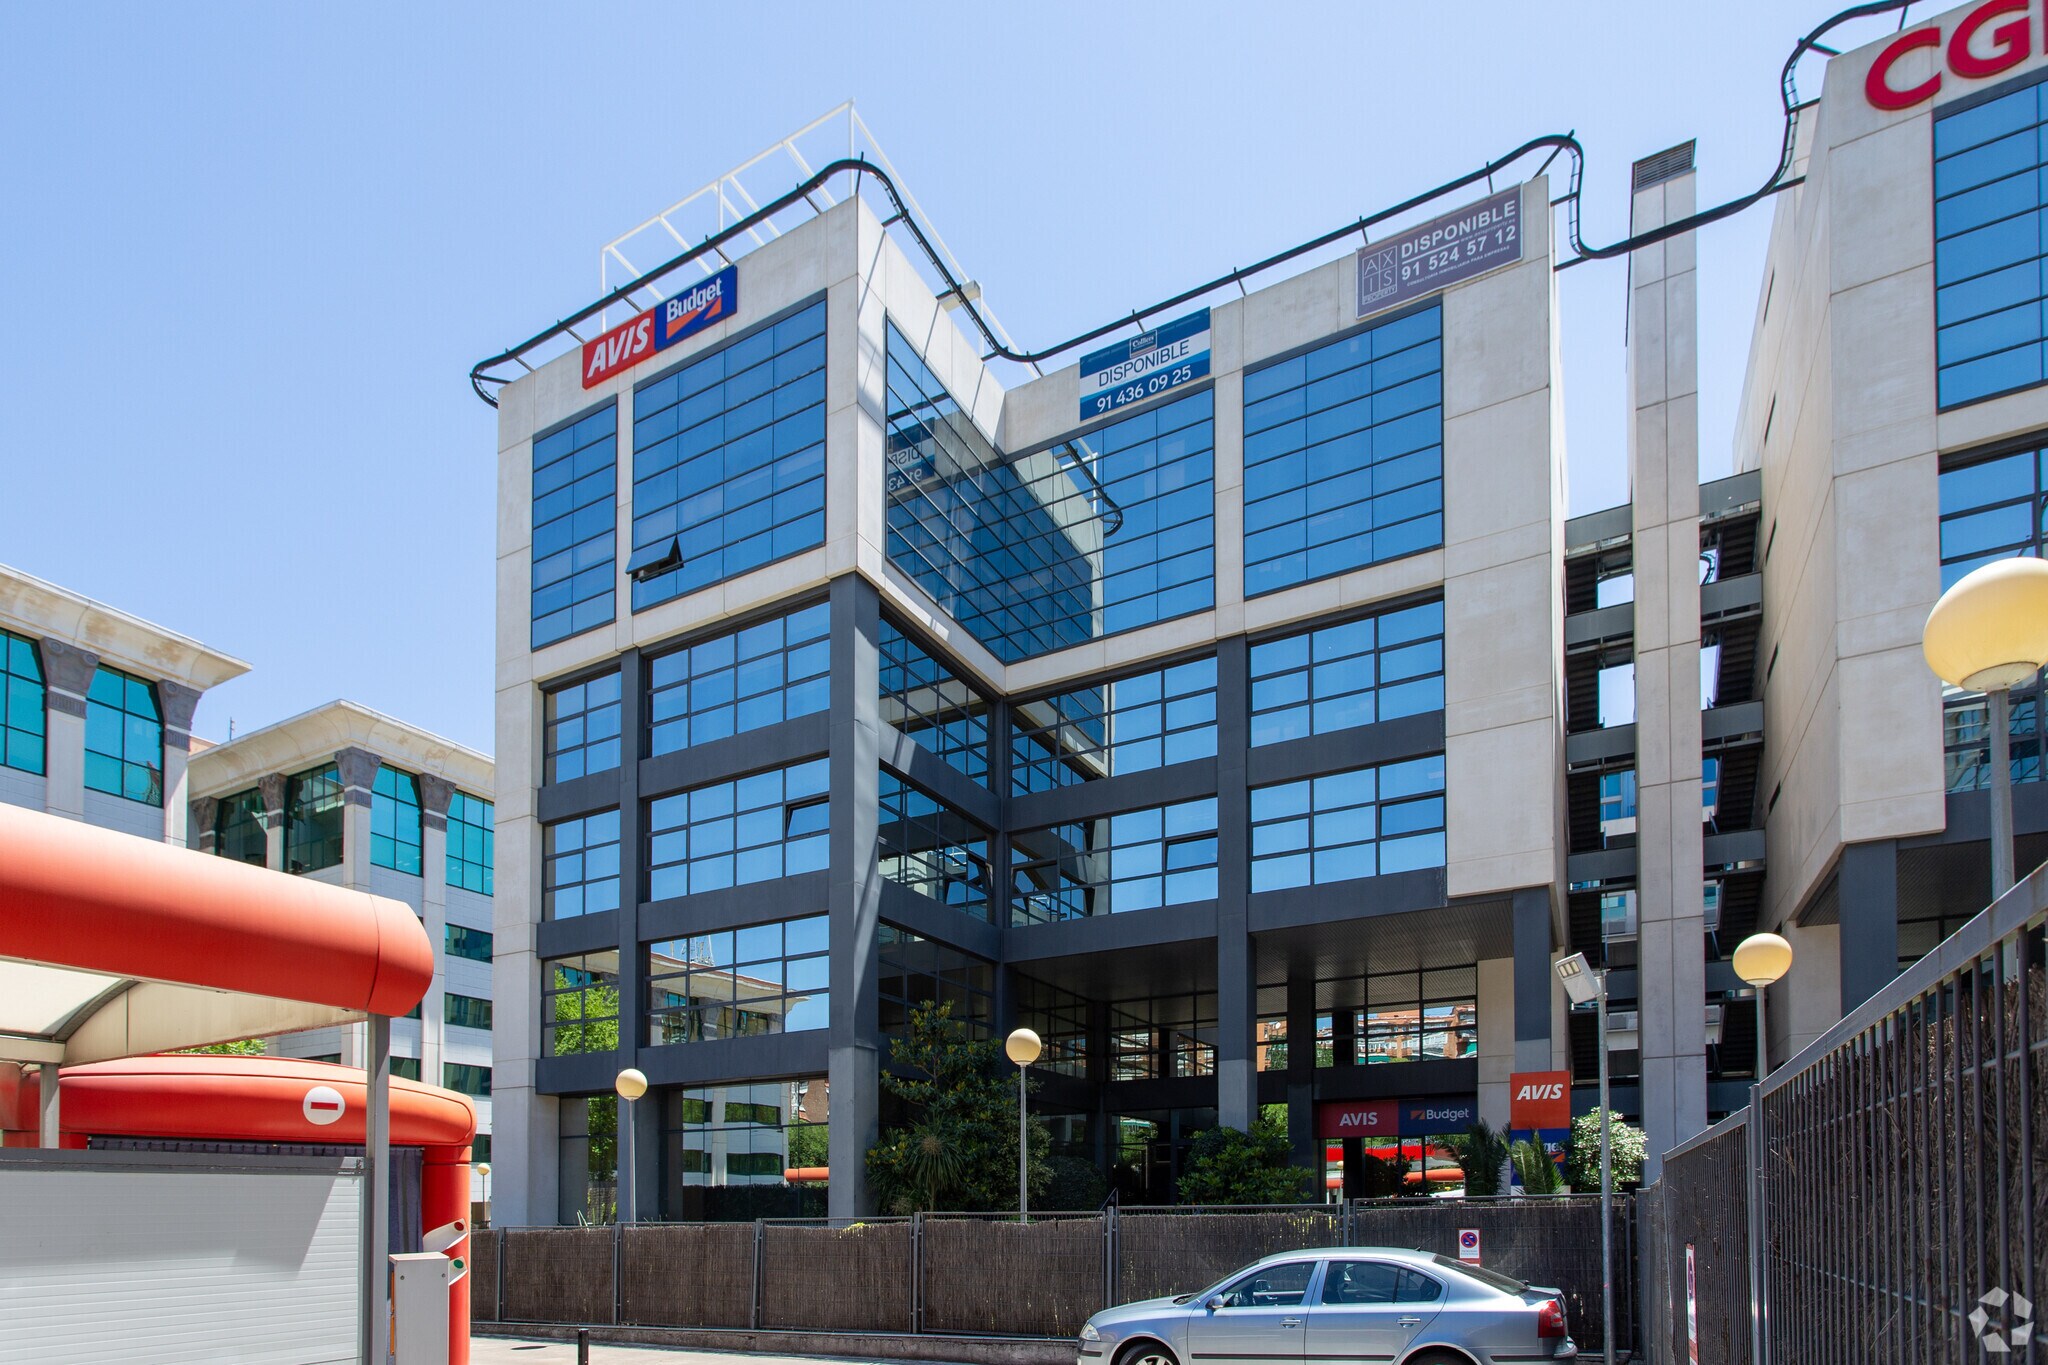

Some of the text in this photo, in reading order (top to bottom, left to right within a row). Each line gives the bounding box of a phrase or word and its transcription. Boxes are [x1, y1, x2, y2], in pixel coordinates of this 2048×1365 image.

[1865, 0, 2048, 111] CG
[1401, 200, 1516, 258] DISPONIBLE
[1401, 225, 1516, 280] 91 524 57 12
[666, 277, 722, 323] Budget
[586, 318, 651, 379] AVIS
[1098, 339, 1190, 388] DISPONIBLE
[1097, 365, 1191, 413] 91 436 09 25
[1516, 1083, 1564, 1101] AVIS
[1339, 1108, 1470, 1127] AVIS Budget
